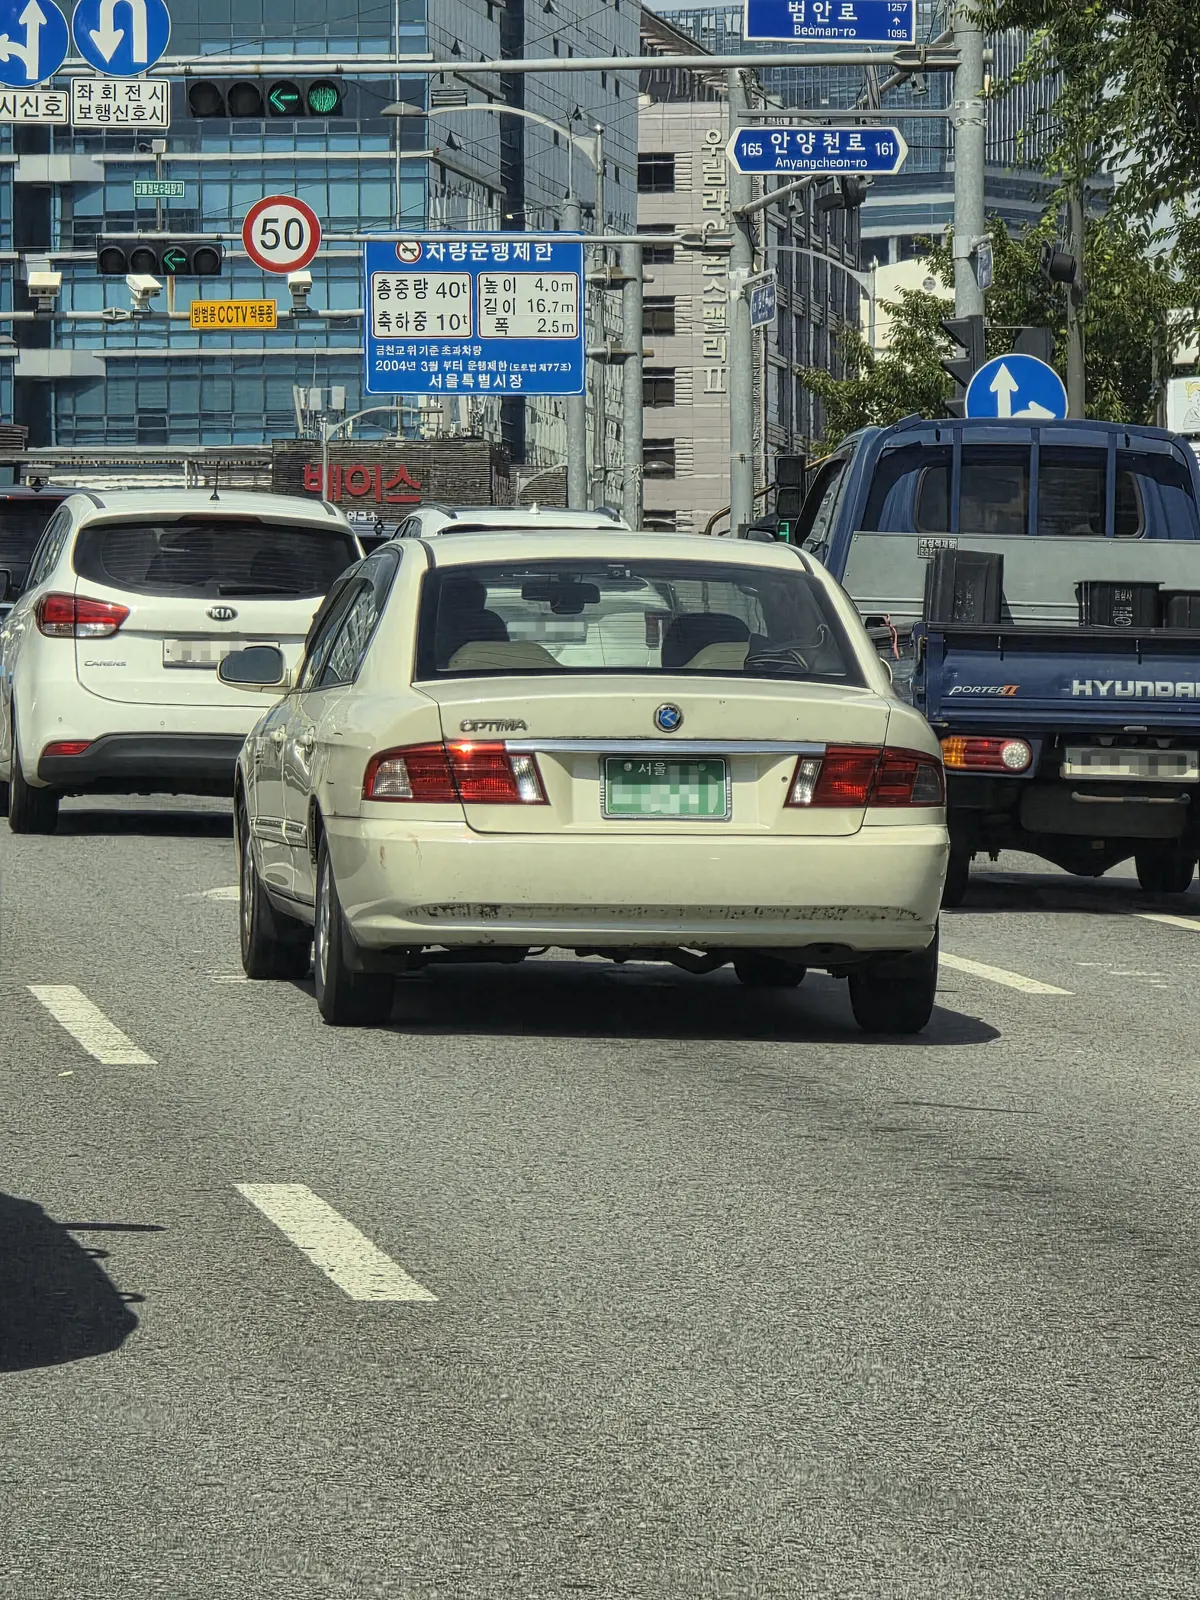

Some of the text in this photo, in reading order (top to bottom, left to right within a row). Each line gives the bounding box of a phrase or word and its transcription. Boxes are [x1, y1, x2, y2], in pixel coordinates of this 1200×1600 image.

[788, 1, 858, 22] 범안로
[887, 3, 908, 12] 1257
[794, 25, 857, 37] Beoman-ro
[887, 29, 908, 38] 1095
[0, 94, 64, 118] 시신호
[77, 103, 164, 123] 보행신호시
[741, 143, 763, 157] 165
[771, 131, 866, 155] 안양천로
[875, 142, 894, 156] 161
[775, 157, 868, 170] Anyangcheon-ro
[259, 217, 304, 251] 50
[425, 242, 553, 262] 차량운행제한
[376, 277, 467, 300] 총중량 40t
[483, 276, 517, 295] 높이
[483, 298, 574, 316] 길이 16.7m
[377, 311, 468, 332] 축하중 10t
[494, 318, 574, 335] 폭 2.5m
[375, 360, 416, 371] 2004년
[421, 361, 438, 372] 3월
[443, 360, 463, 372] 부터
[468, 360, 507, 372] 운행제한
[428, 373, 523, 389] 서울특별시장
[303, 464, 421, 503] 베이스
[211, 608, 233, 618] KIA
[460, 718, 528, 732] OPTIMA
[638, 762, 666, 776] 서울
